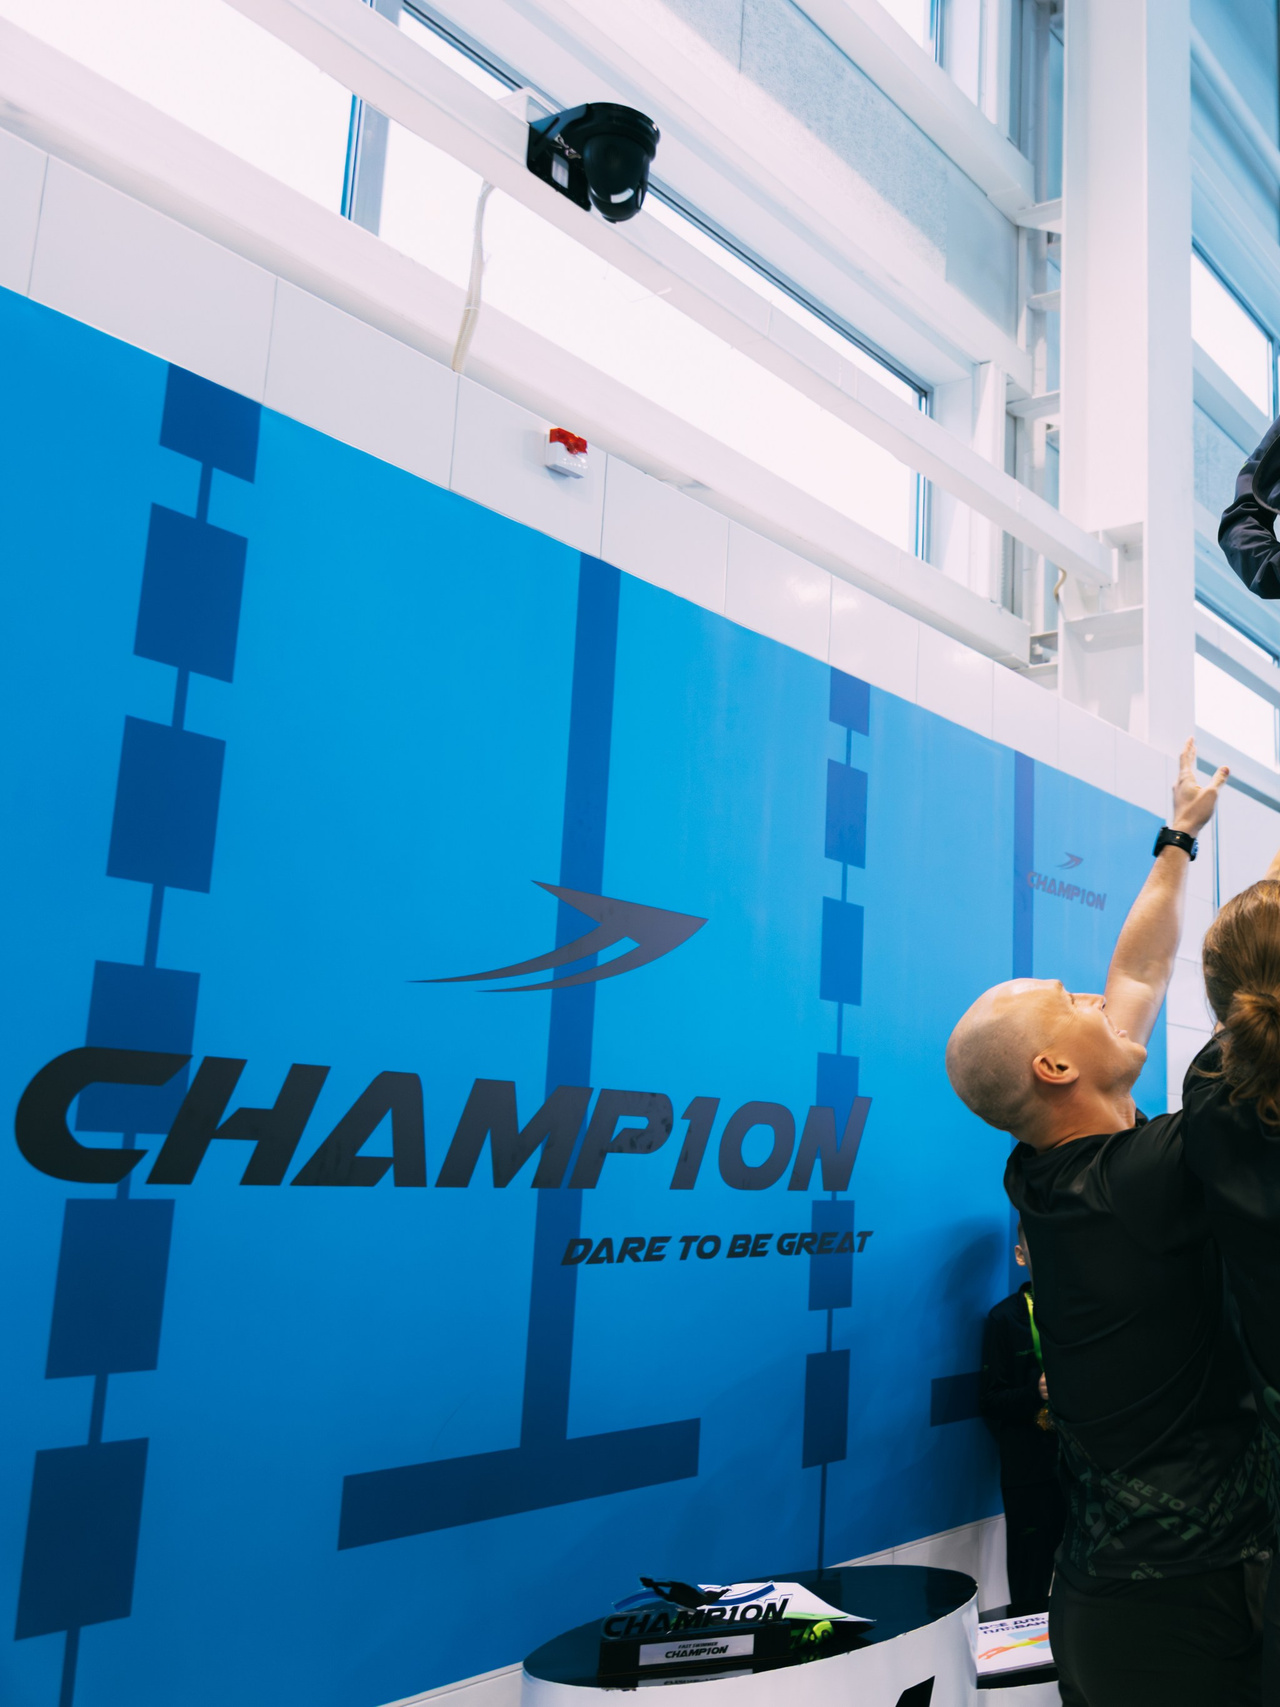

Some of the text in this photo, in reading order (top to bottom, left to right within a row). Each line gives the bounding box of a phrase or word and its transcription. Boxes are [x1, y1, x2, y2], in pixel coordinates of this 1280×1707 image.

[560, 1231, 875, 1266] DARE TO BE GREAT
[1159, 1492, 1186, 1511] TO
